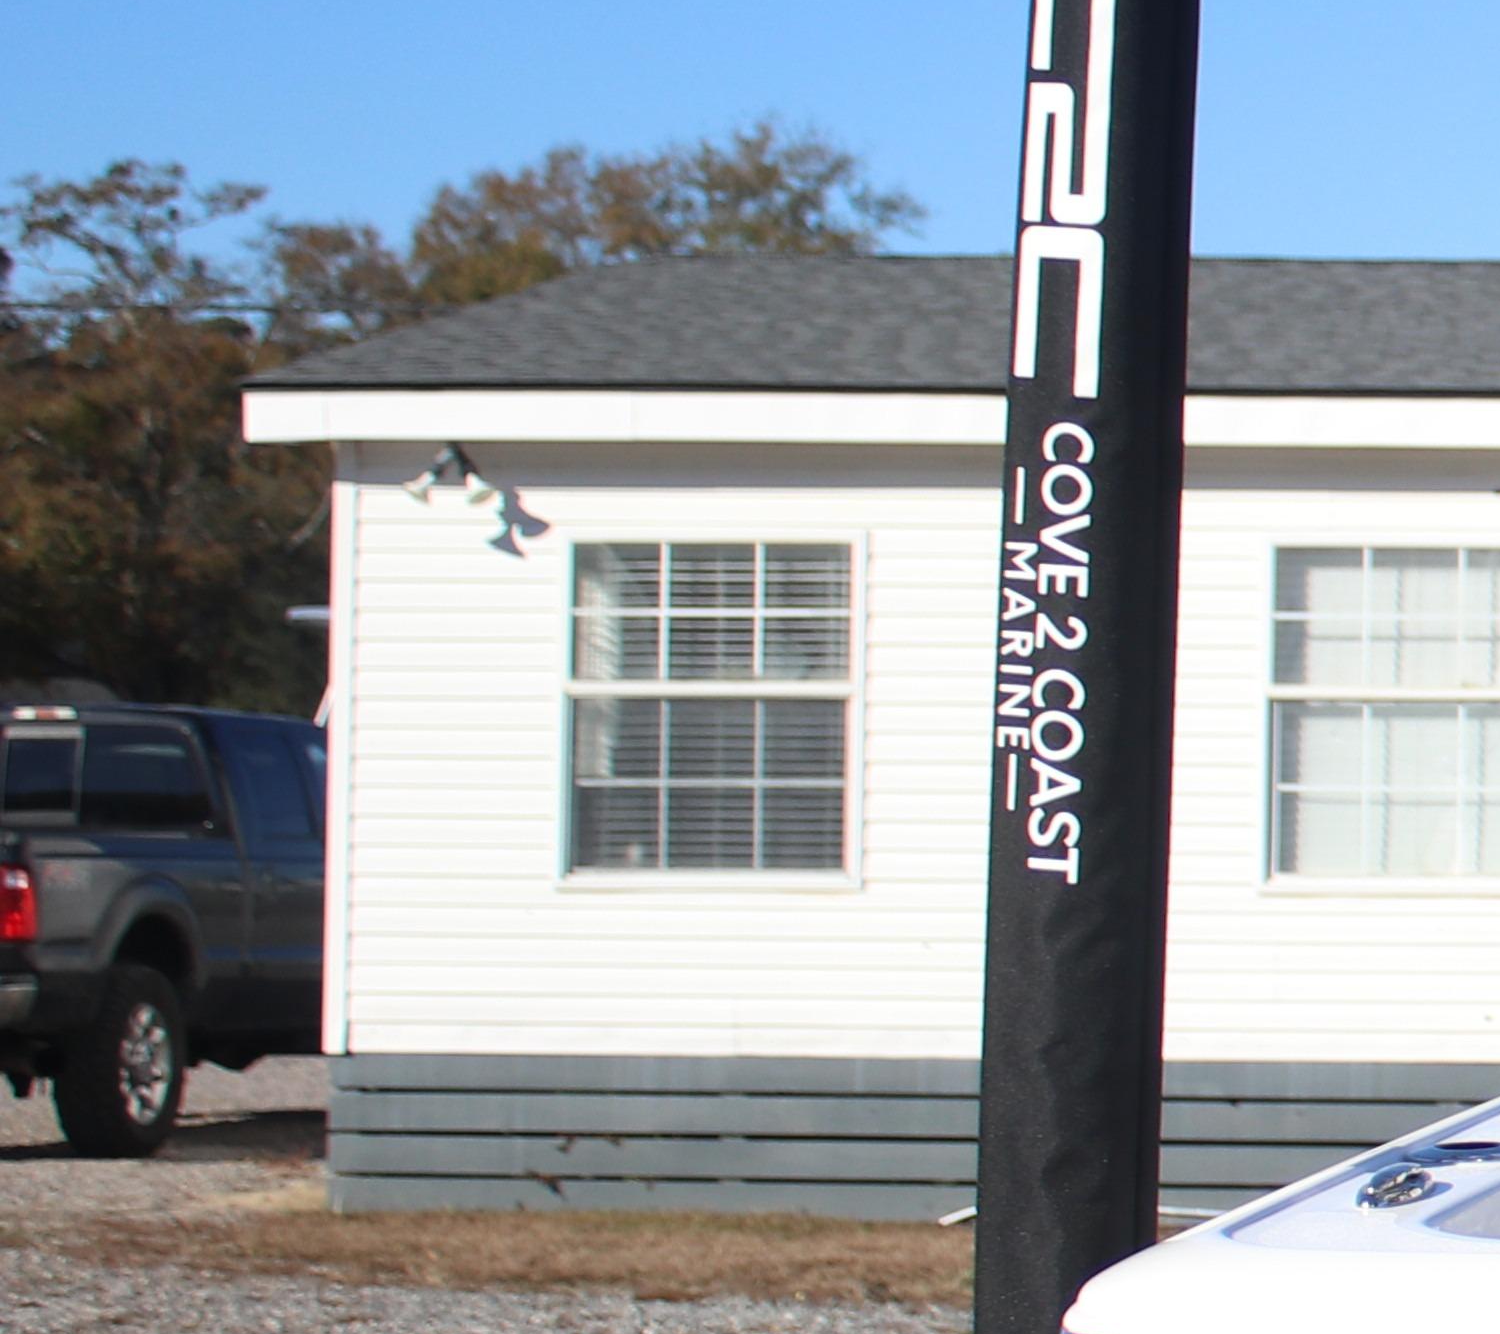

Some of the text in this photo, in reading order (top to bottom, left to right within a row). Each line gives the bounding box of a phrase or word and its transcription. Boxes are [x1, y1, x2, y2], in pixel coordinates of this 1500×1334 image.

[996, 540, 1039, 751] MARINE
[1026, 422, 1095, 886] COVE 2 COAST
